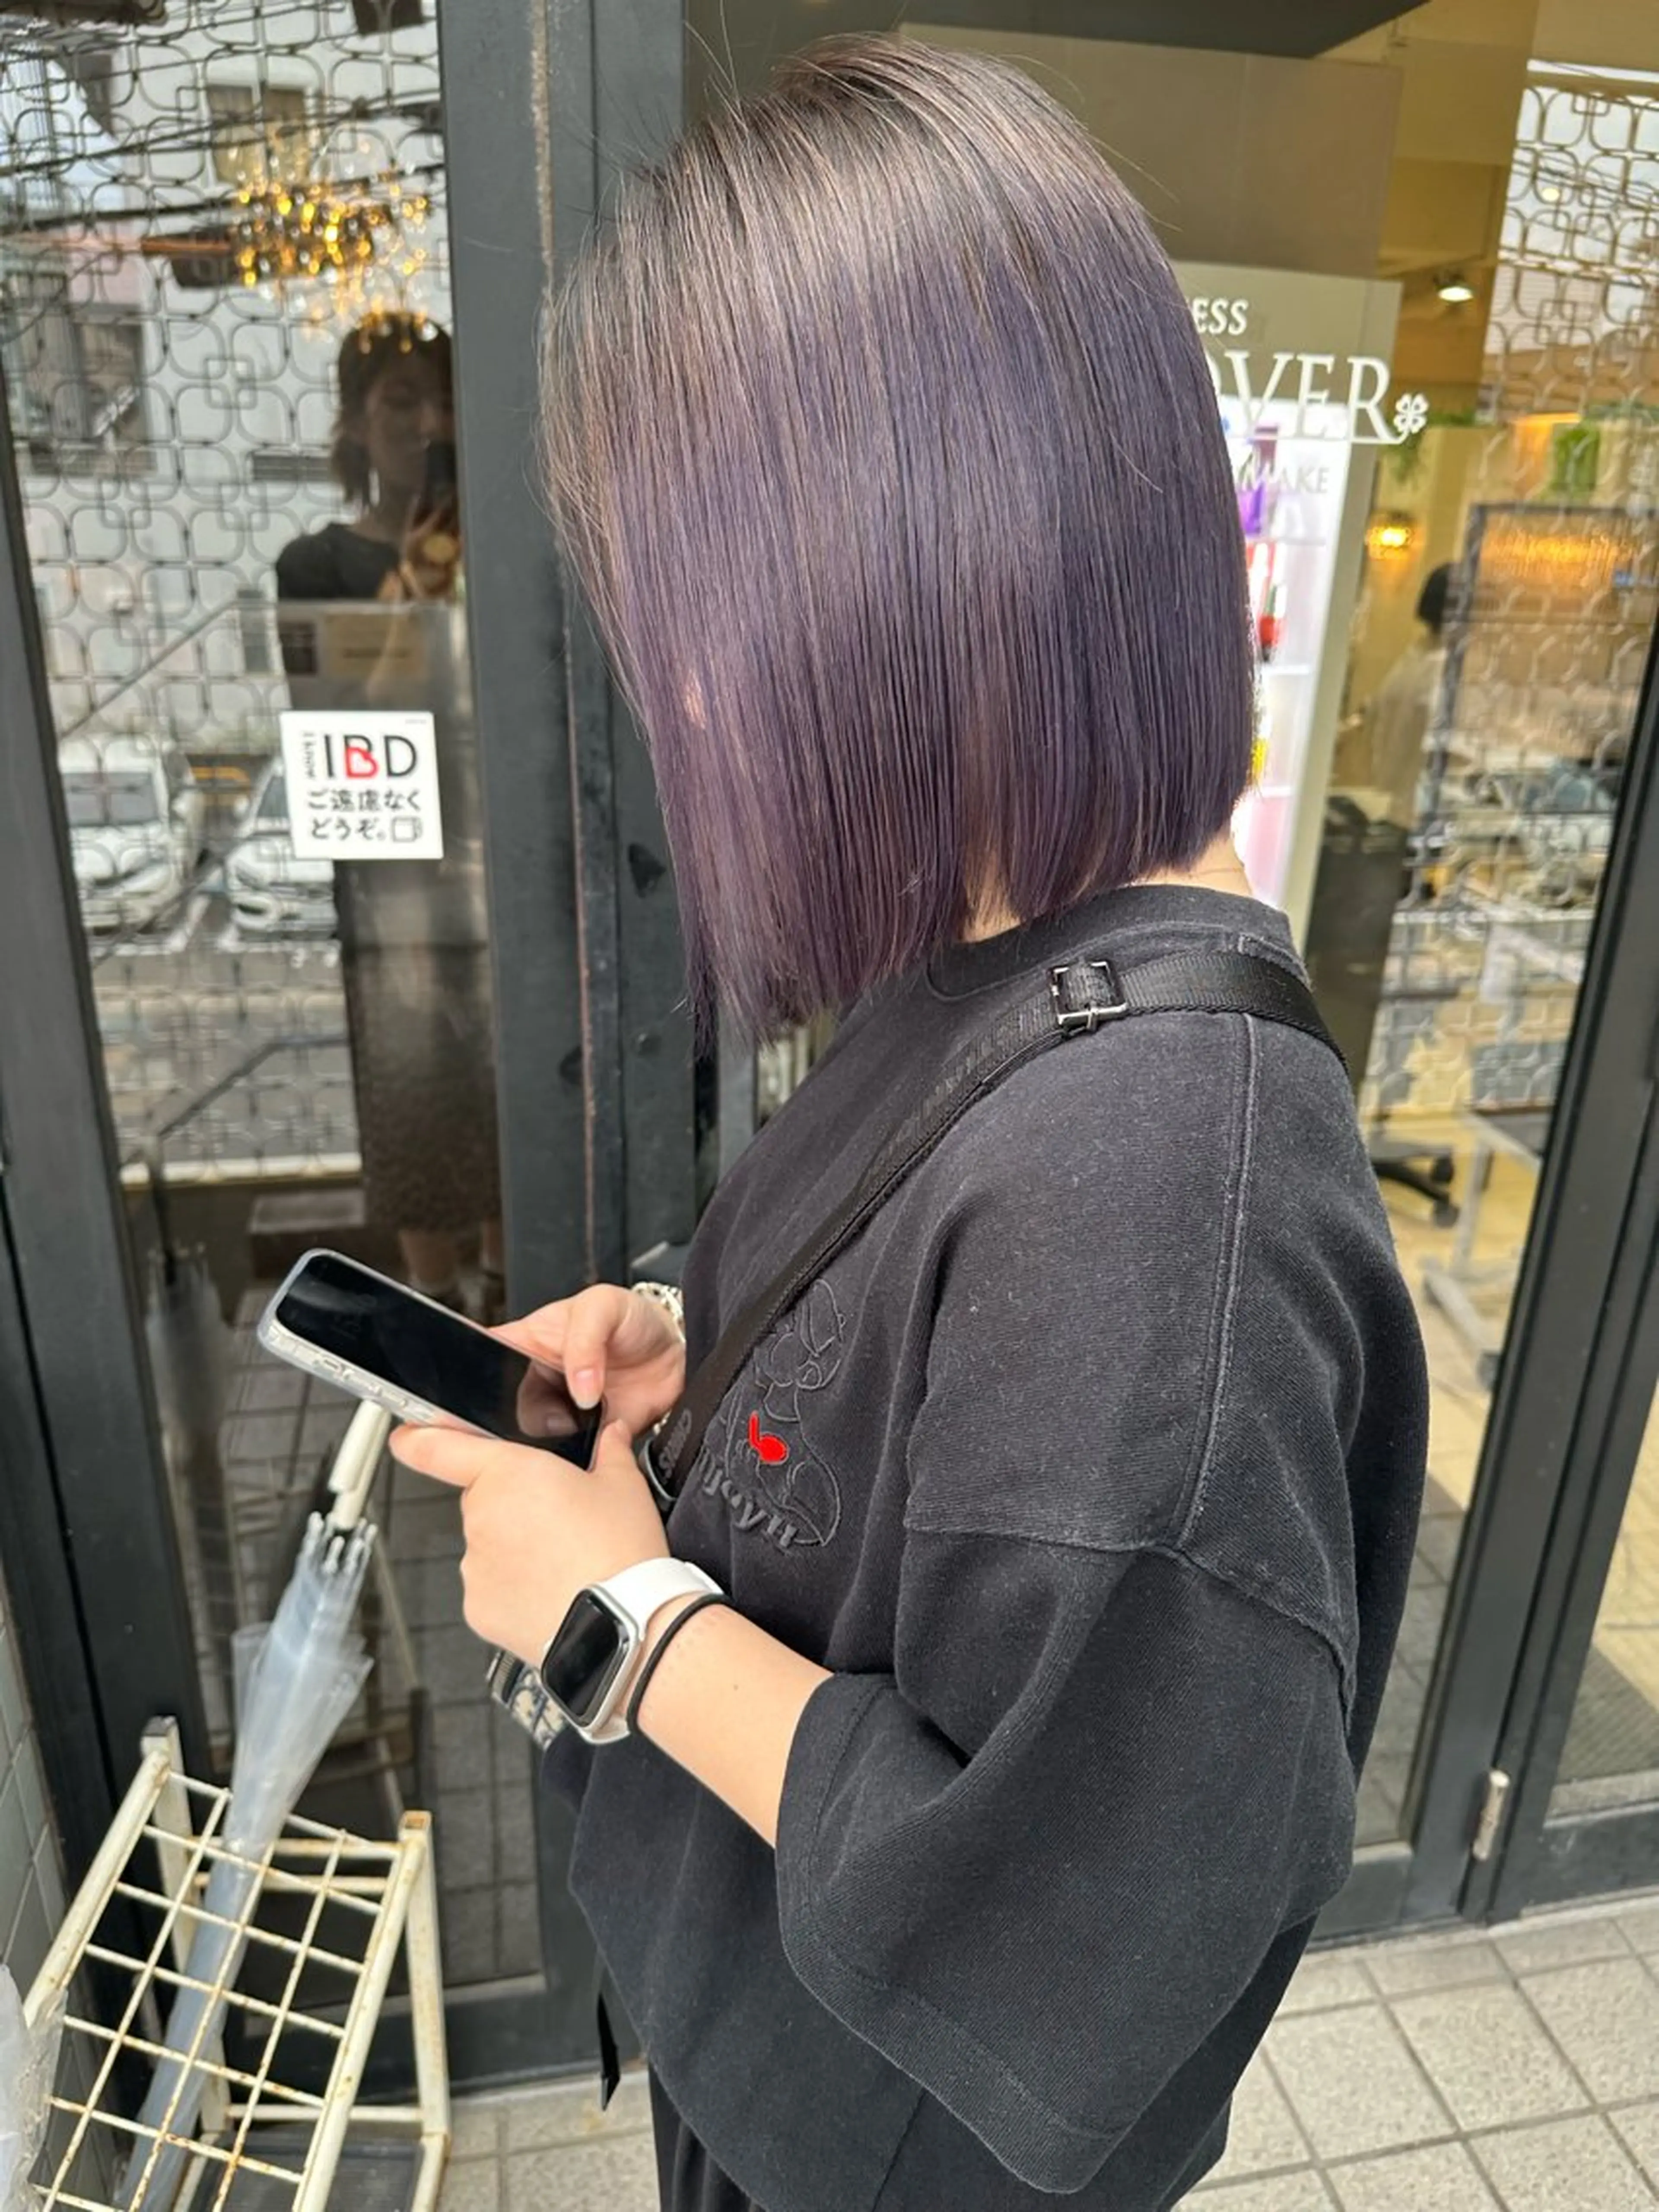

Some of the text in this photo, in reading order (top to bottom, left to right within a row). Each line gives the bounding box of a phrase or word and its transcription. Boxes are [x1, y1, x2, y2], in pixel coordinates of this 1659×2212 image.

[1187, 296, 1249, 336] ESS
[1207, 350, 1400, 444] VER
[324, 734, 417, 779] IBD
[308, 789, 421, 811] ご遠慮なく
[311, 818, 385, 841] どうぞ。
